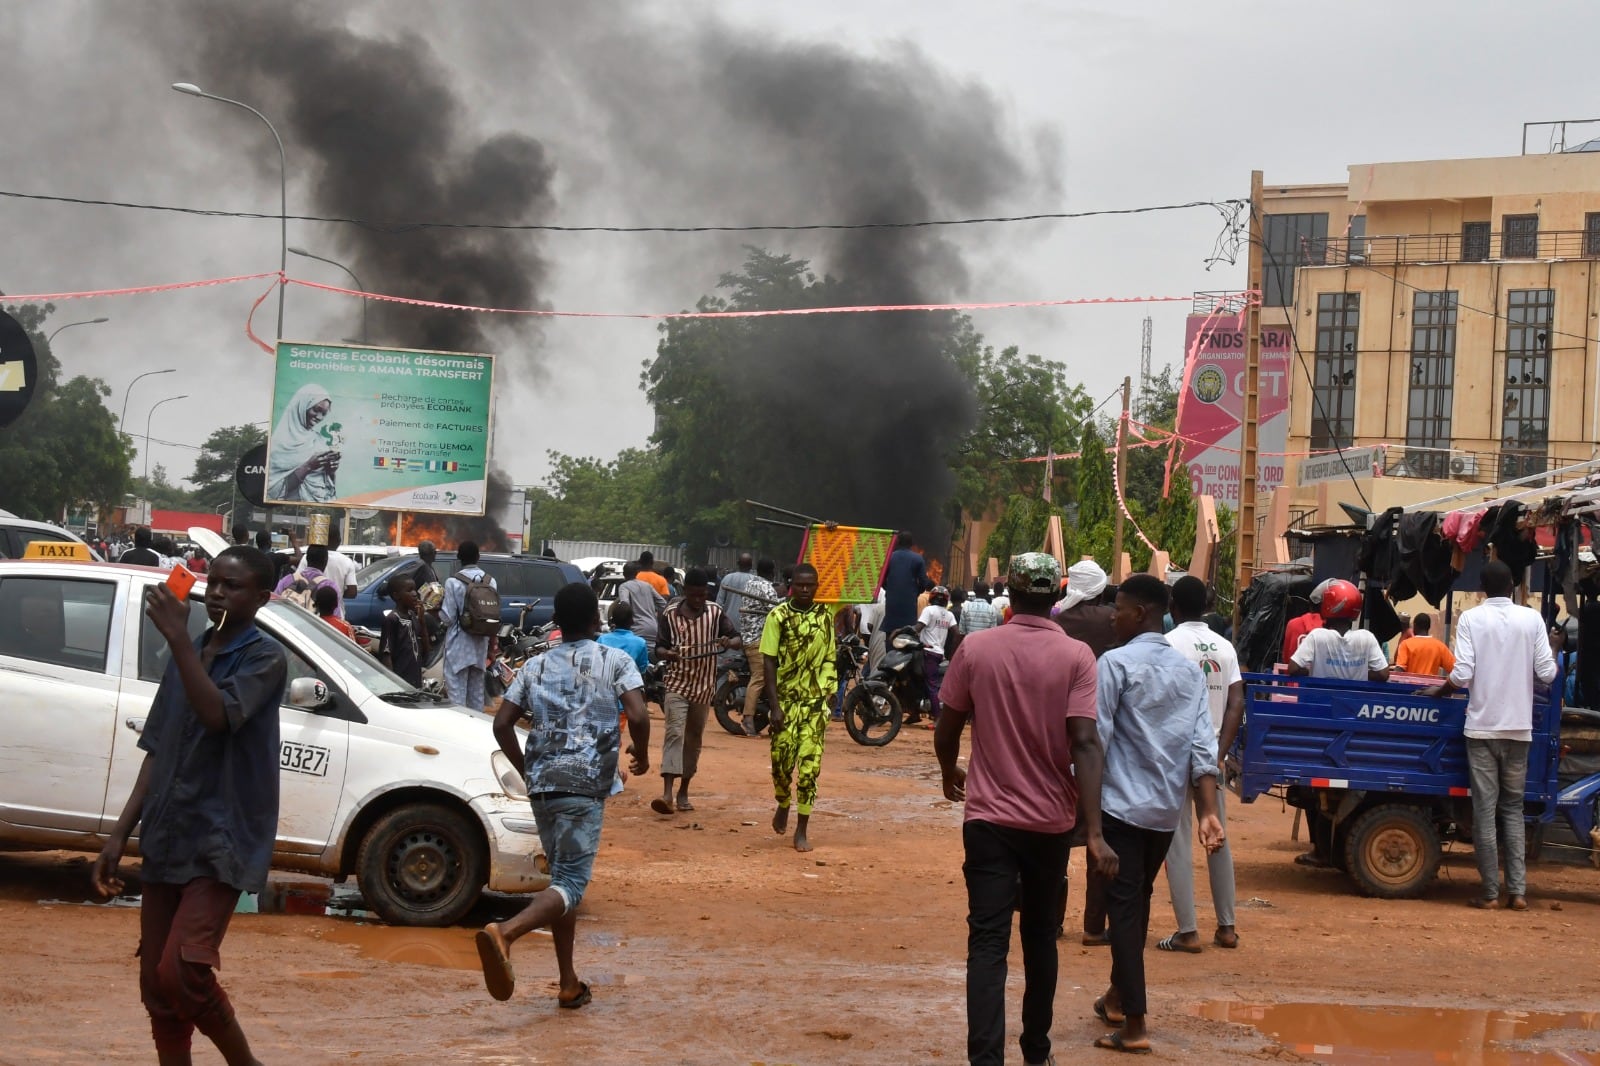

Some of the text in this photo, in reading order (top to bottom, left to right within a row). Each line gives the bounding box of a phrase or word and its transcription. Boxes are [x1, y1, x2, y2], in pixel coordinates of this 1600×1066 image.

[290, 347, 485, 370] Services Ecobank désormais
[289, 359, 484, 380] disponibles à AMANA TRANSFERT
[381, 393, 464, 406] Recharge de cartes
[426, 403, 472, 413] ECOBANK
[379, 419, 483, 433] Paiement de FACTURES
[376, 446, 390, 454] via
[377, 438, 474, 452] Transfert hors UEMOA
[38, 545, 76, 557] TAXI
[1357, 704, 1440, 723] APSONIC
[280, 745, 326, 772] 9327
